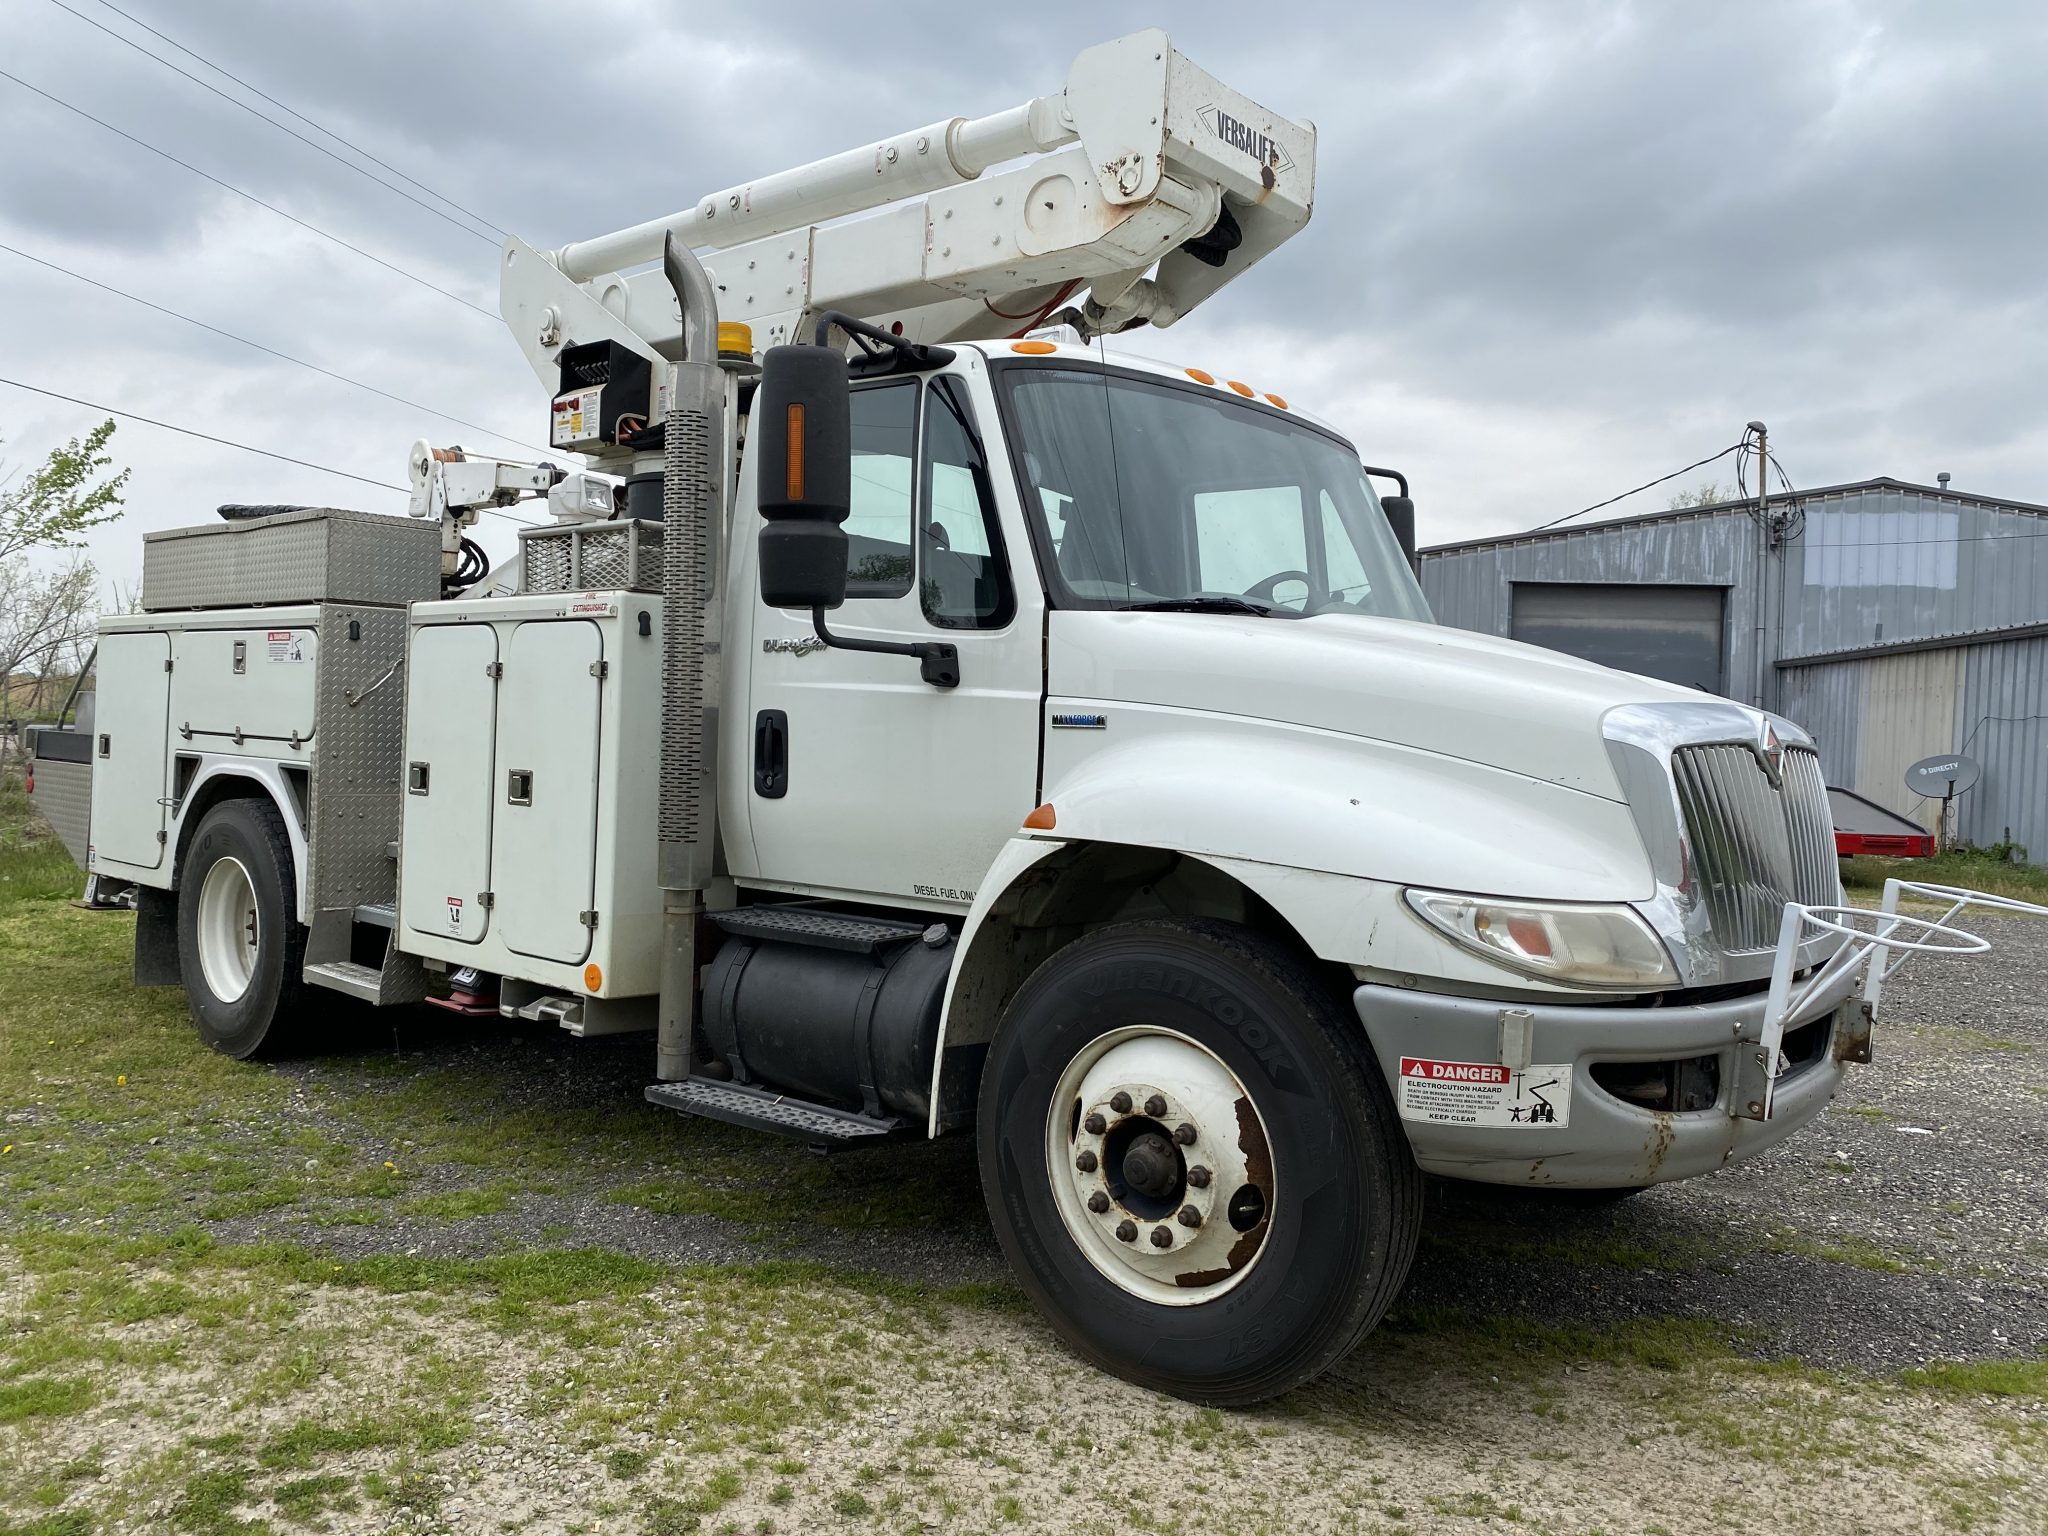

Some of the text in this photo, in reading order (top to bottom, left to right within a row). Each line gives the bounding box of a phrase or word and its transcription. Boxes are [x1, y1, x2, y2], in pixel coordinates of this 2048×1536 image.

[1217, 109, 1275, 167] VERSALIFT
[1927, 762, 1959, 774] DIRECTV
[913, 884, 940, 897] DIESEL
[940, 887, 960, 900] FUEL
[1432, 1064, 1503, 1082] DANGER
[1407, 1080, 1502, 1094] ELECTROCUTION HAZARD
[1428, 1113, 1476, 1123] KEEP CLEAR
